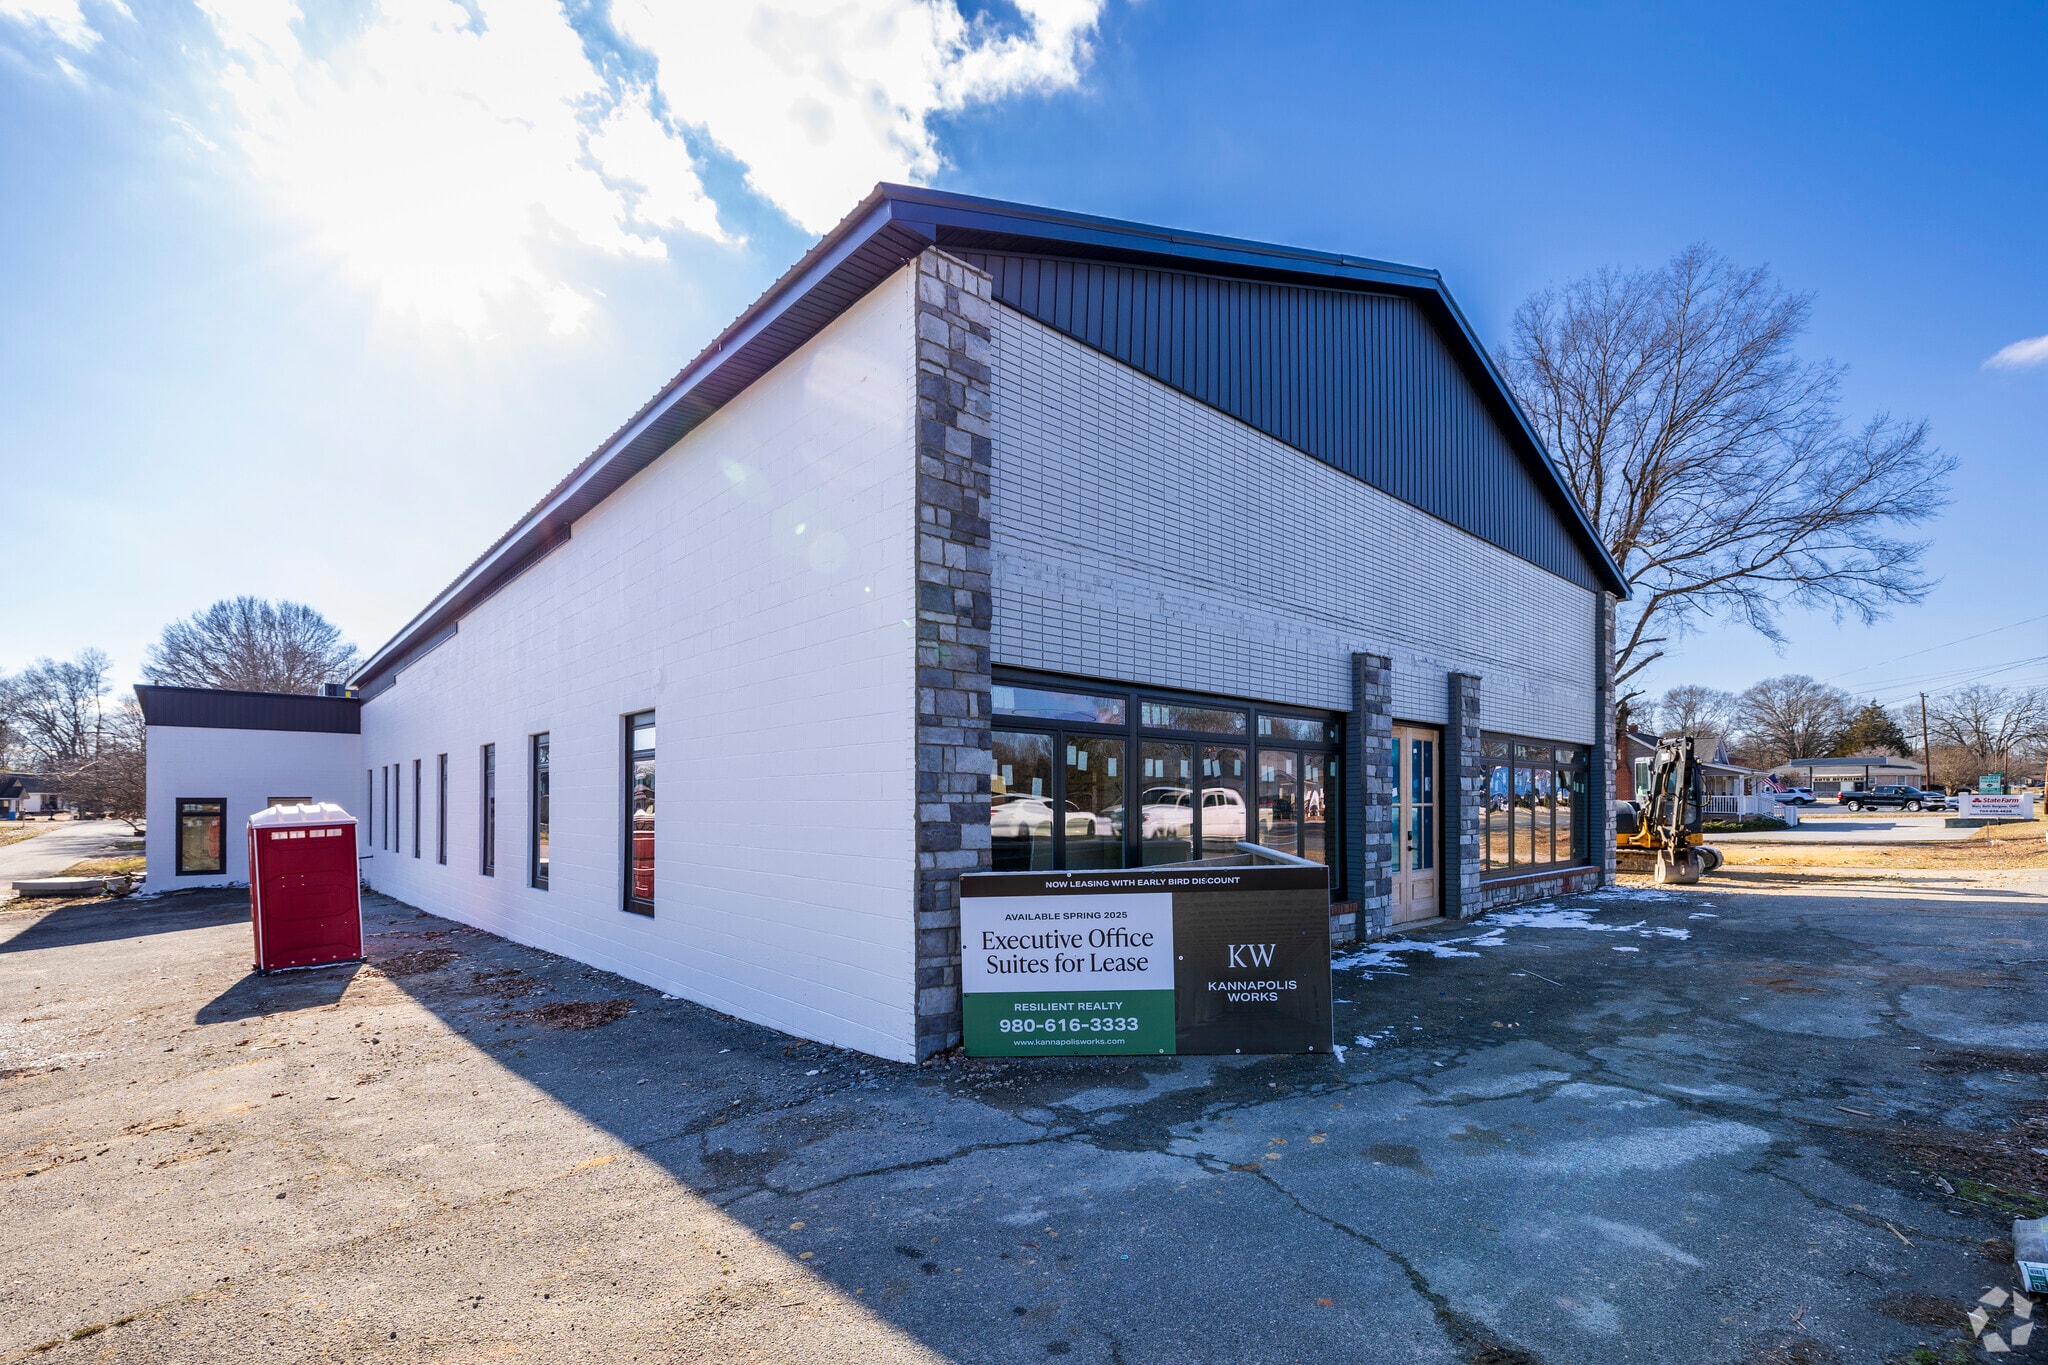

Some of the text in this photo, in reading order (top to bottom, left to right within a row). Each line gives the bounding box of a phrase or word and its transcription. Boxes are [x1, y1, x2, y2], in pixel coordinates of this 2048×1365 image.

[1045, 877, 1241, 889] NOW LEASING WITH EARLY BIRD DISCOUNT
[1005, 911, 1128, 921] AVAILABLE SPRING 2025
[982, 927, 1154, 950] Executive Office
[1228, 943, 1276, 968] KW
[986, 952, 1149, 975] Suites for Lease
[1208, 980, 1297, 991] KANNAPOLIS
[1227, 992, 1278, 1002] WORKS
[1014, 1001, 1123, 1011] RESILIENT REALTY
[999, 1017, 1139, 1033] 980-616-3333
[1013, 1038, 1125, 1047] www.kannapolisworks.com
